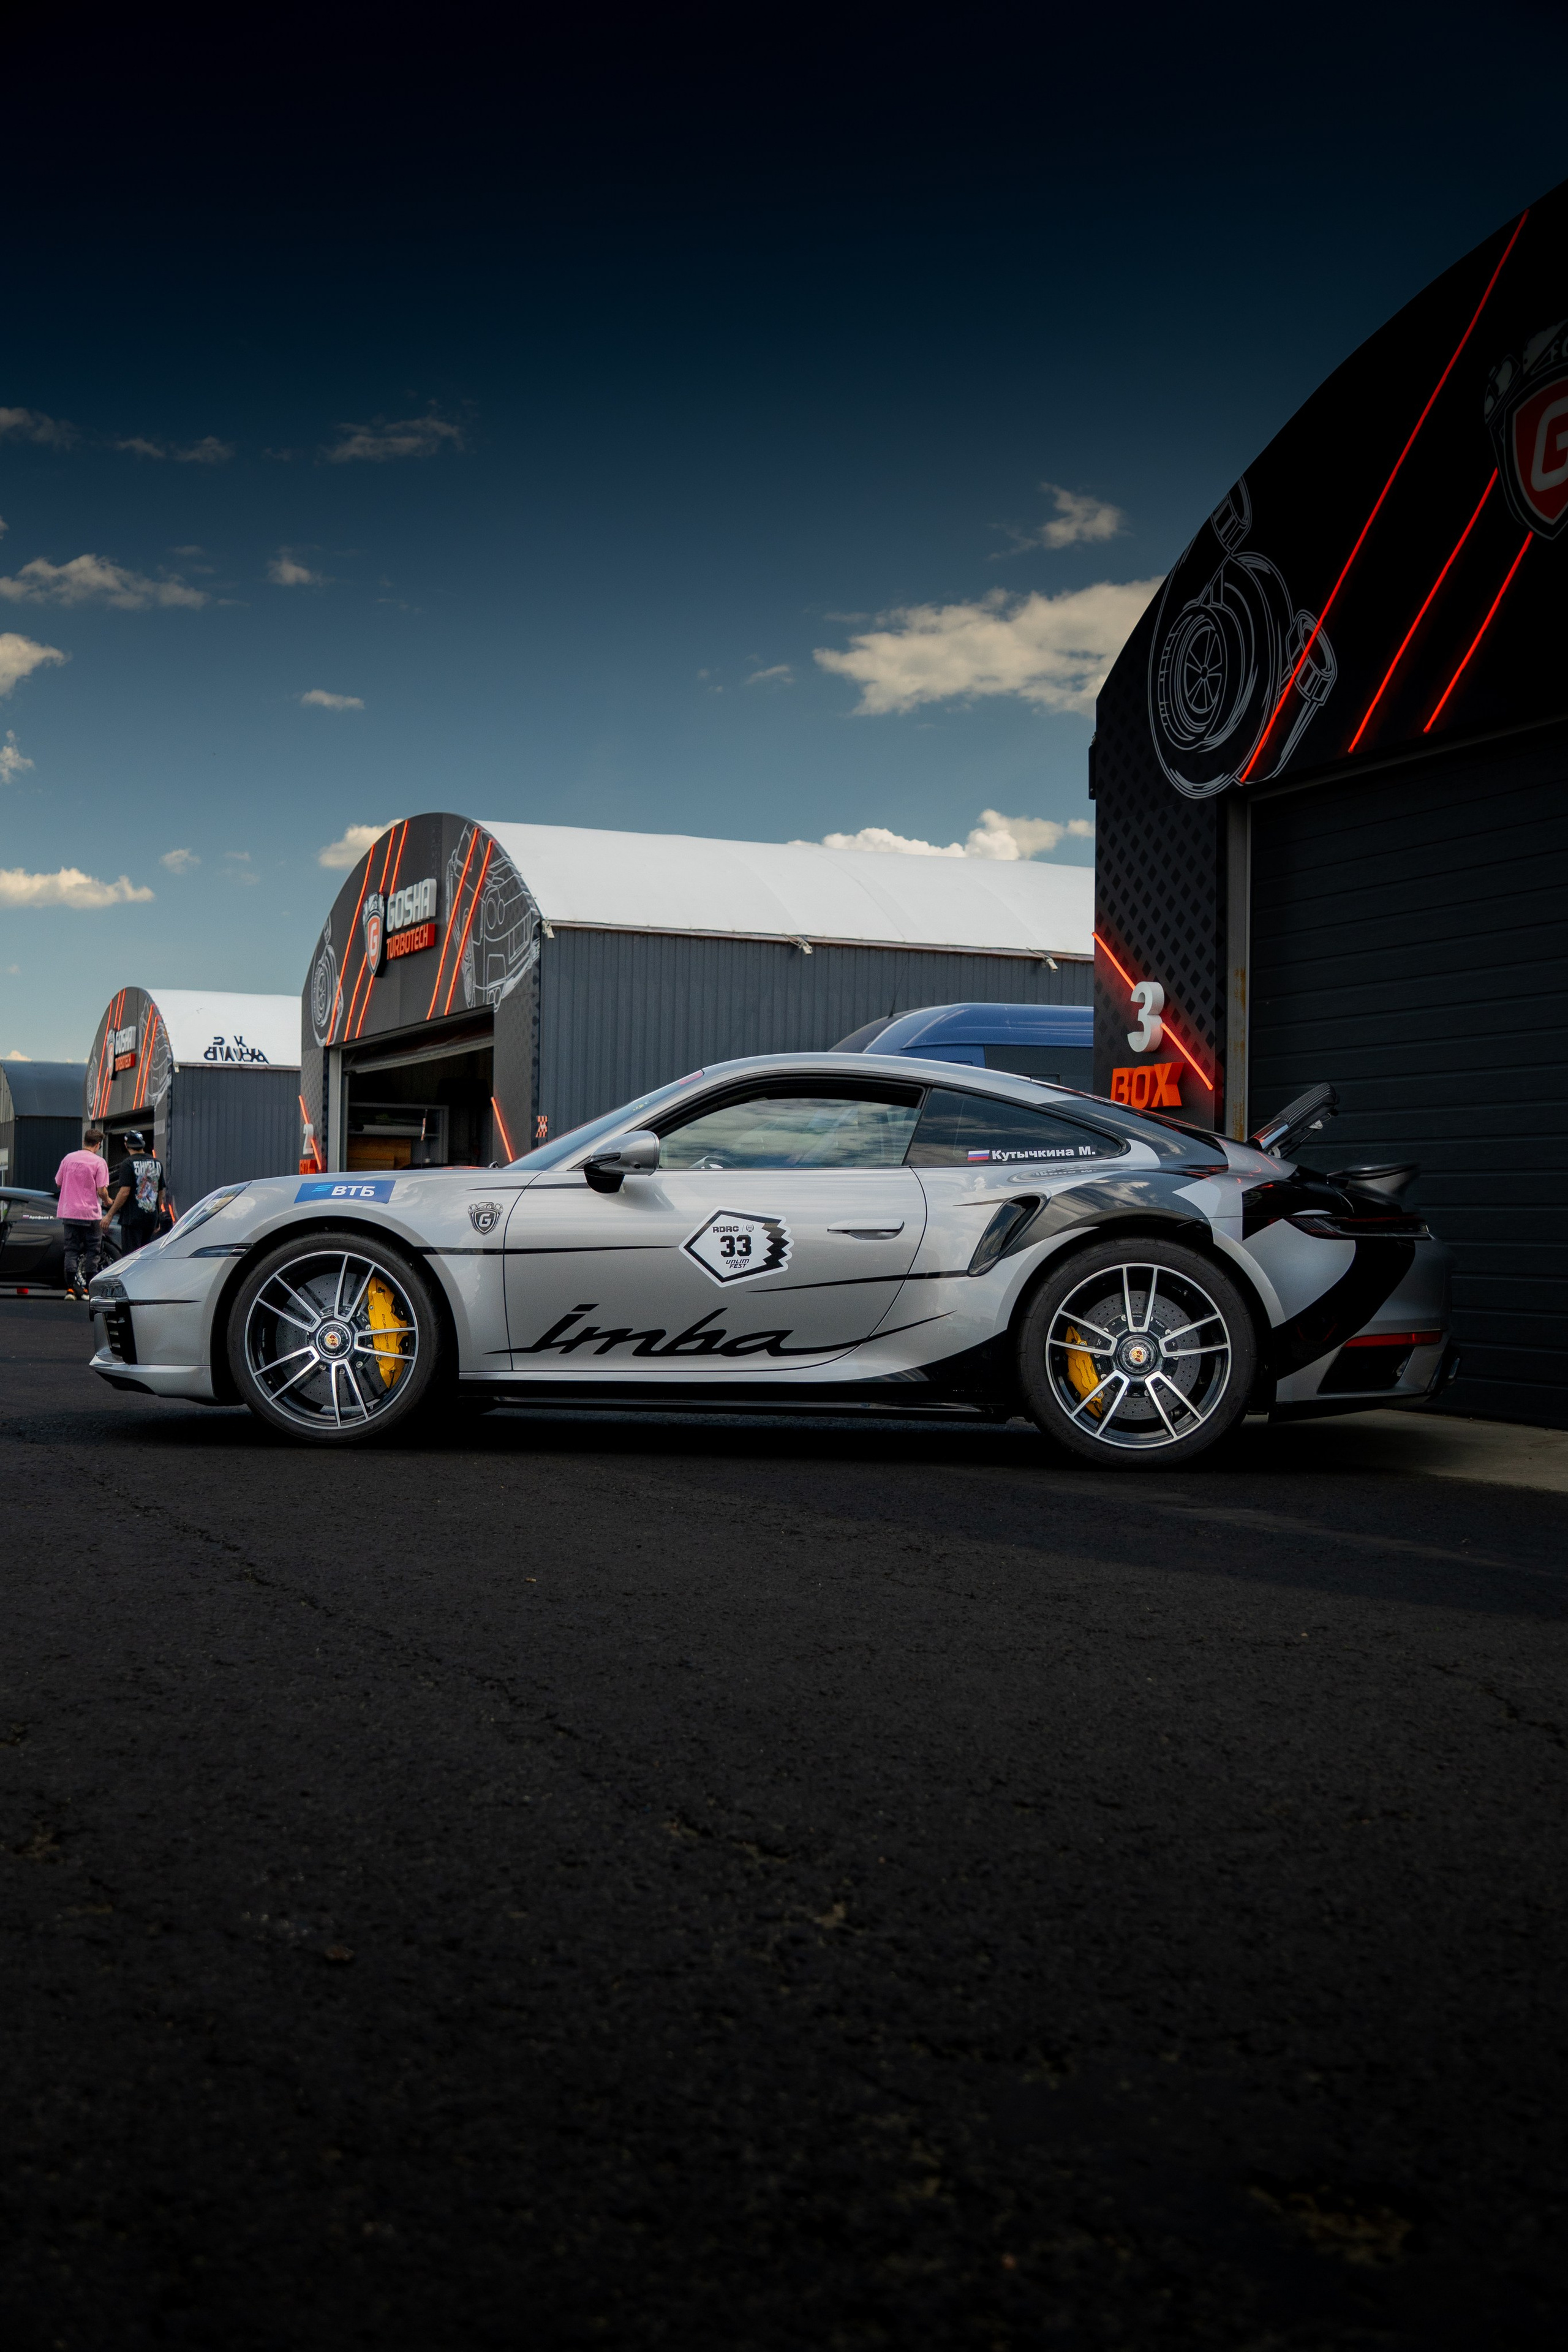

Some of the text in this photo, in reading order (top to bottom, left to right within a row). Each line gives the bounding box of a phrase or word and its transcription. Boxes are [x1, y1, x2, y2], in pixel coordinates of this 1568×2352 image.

[386, 878, 437, 933] GOSHA
[386, 923, 436, 960] TURBOTECH
[1127, 981, 1164, 1052] 3
[1110, 1062, 1185, 1109] BOX
[303, 1123, 314, 1155] 2
[992, 1146, 1096, 1161] Кутычкина М.
[331, 1185, 375, 1197] ВТБ
[720, 1234, 752, 1257] 33
